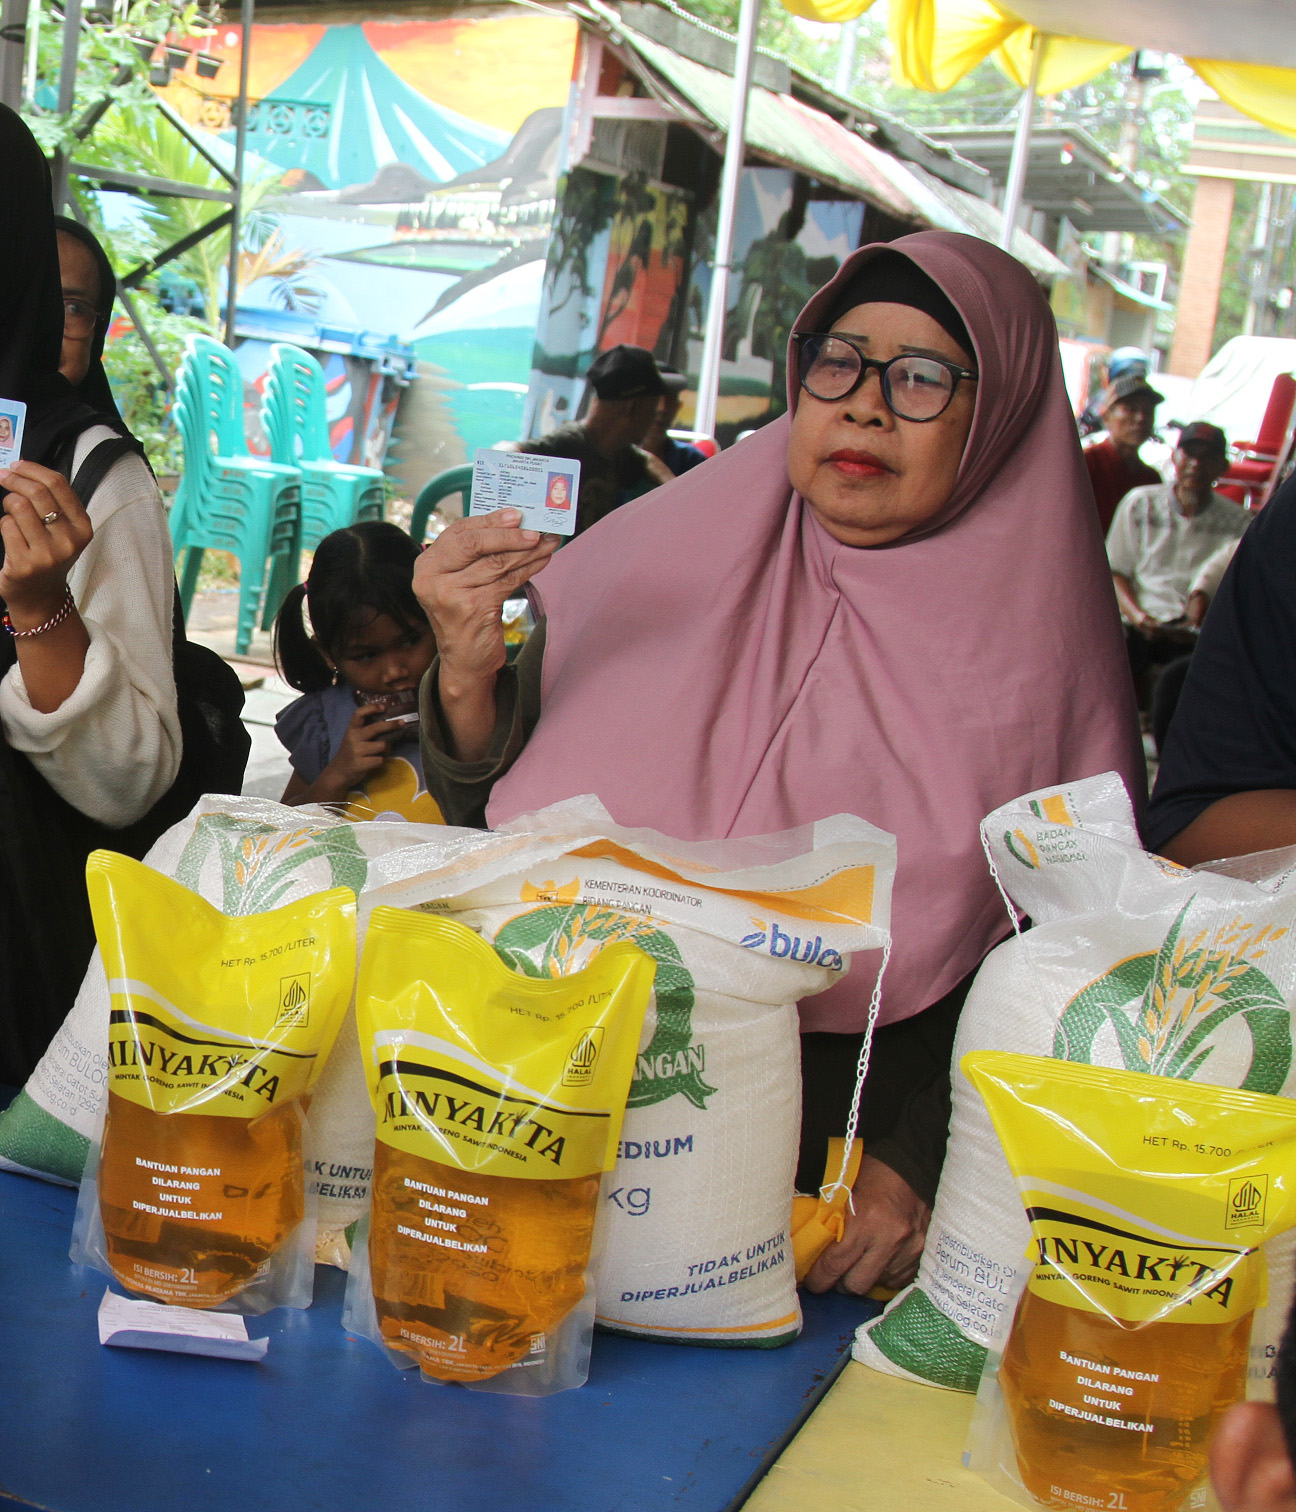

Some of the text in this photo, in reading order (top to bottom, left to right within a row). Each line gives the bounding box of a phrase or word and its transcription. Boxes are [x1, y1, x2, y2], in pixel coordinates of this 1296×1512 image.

[1036, 827, 1071, 842] BADAN
[643, 882, 703, 908] KOORDINATOR
[221, 958, 241, 968] HET
[244, 956, 256, 967] Rp.
[284, 937, 316, 952] /LITER
[115, 1073, 140, 1081] MINYAK
[177, 1082, 199, 1090] SAWIT
[616, 1134, 694, 1160] EDIUM
[1143, 1135, 1169, 1147] HET
[1172, 1139, 1190, 1152] Rp.
[1194, 1144, 1231, 1157] 15.700
[135, 1157, 221, 1176] BANTUAN PANGAN
[152, 1177, 200, 1190] DILARANG
[404, 1177, 489, 1206] BANTUAN PANGAN
[159, 1193, 192, 1205] UNTUK
[418, 1199, 467, 1218] DILARANG
[132, 1201, 223, 1221] DIPERJUALBELIKAN
[1231, 1211, 1259, 1219] HALAL
[424, 1217, 457, 1232] UNTUK
[397, 1224, 488, 1253] DIPERJUALBELIKAN
[688, 1230, 785, 1277] TIDAK UNTUK
[134, 1263, 143, 1274] ISI
[144, 1265, 178, 1282] BERSIH:
[180, 1268, 198, 1284] 2L
[620, 1249, 785, 1302] DIPERJUALBELIKAN
[974, 1266, 1008, 1295] BUL
[1036, 1237, 1233, 1308] INYAKITA
[1072, 1273, 1110, 1286] GORENG
[1113, 1282, 1140, 1295] SAWIT
[400, 1328, 467, 1352] ISI BERSIH: 2L
[1060, 1351, 1159, 1383] BANTUAN PANGAN
[1077, 1376, 1133, 1396] DILARANG
[1083, 1395, 1121, 1411] UNTUK
[1049, 1399, 1154, 1433] DIPERJUALBELIKAN
[1051, 1485, 1062, 1496] ISI
[1064, 1490, 1105, 1507] BERSIH:
[1107, 1492, 1128, 1510] 2L
